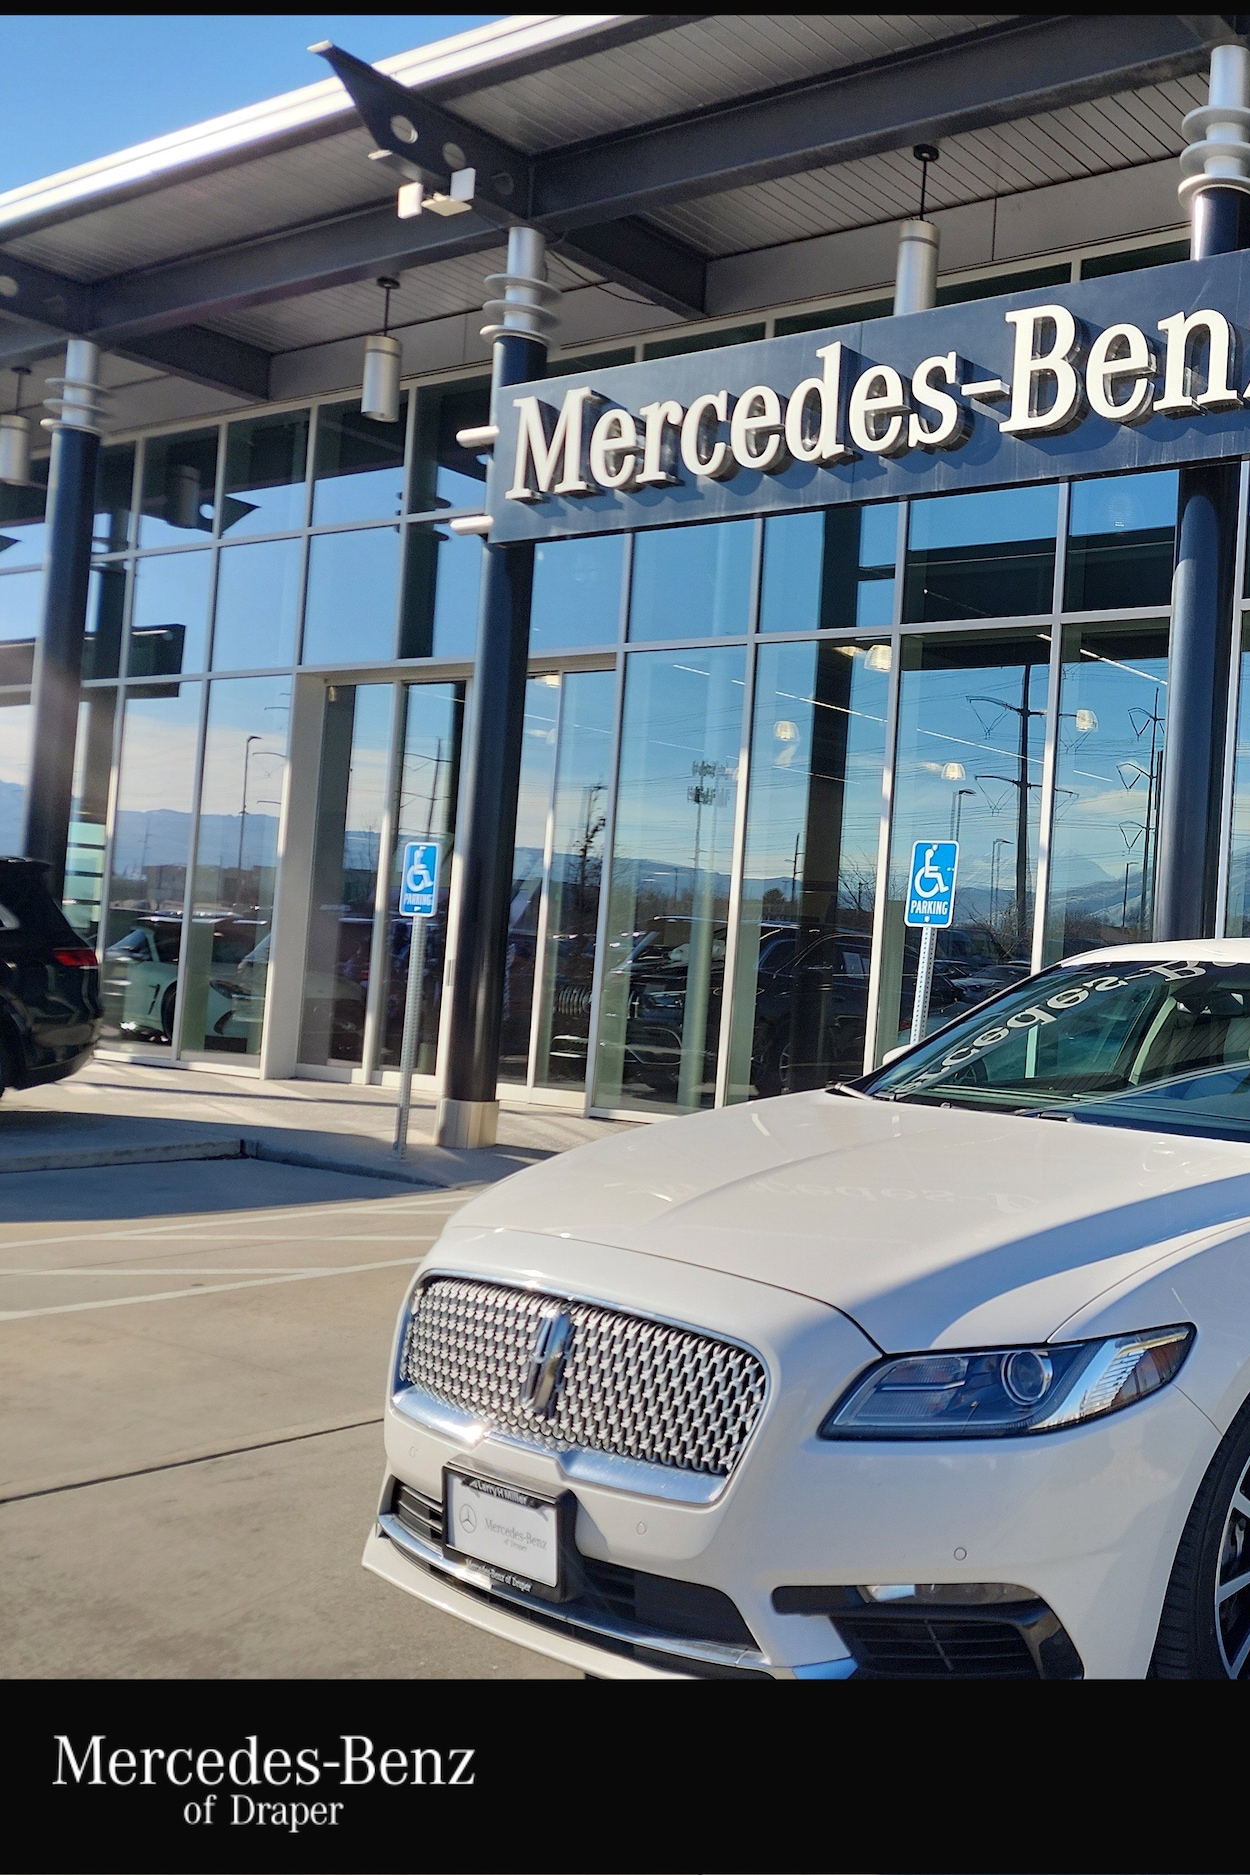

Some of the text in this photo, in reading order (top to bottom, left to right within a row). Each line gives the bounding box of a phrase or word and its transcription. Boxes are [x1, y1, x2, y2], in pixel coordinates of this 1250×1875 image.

[403, 893, 433, 906] PARKING
[910, 900, 949, 916] PARKING
[484, 1517, 547, 1550] Mercedes-Benz
